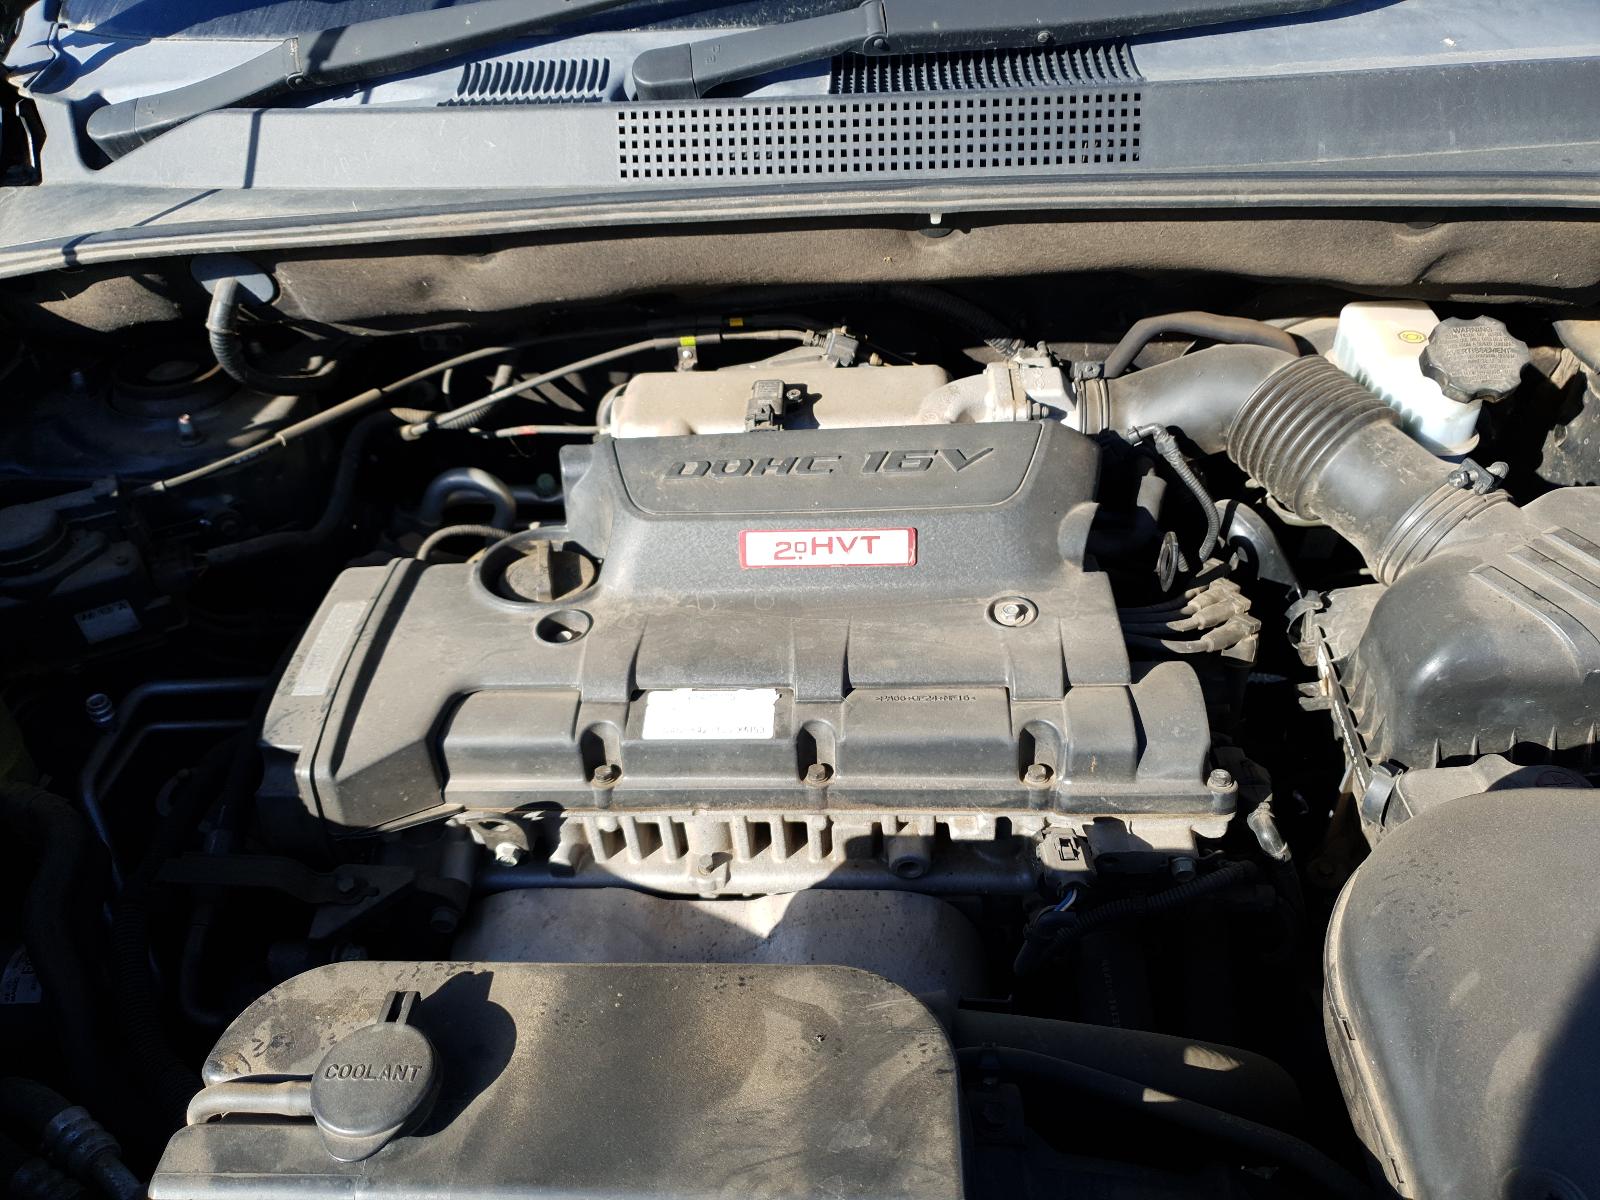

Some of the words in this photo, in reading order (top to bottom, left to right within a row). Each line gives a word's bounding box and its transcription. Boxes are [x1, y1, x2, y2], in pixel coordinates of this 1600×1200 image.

[663, 455, 842, 480] DOHC
[861, 447, 994, 474] 16V
[324, 1063, 423, 1082] COOLANT
